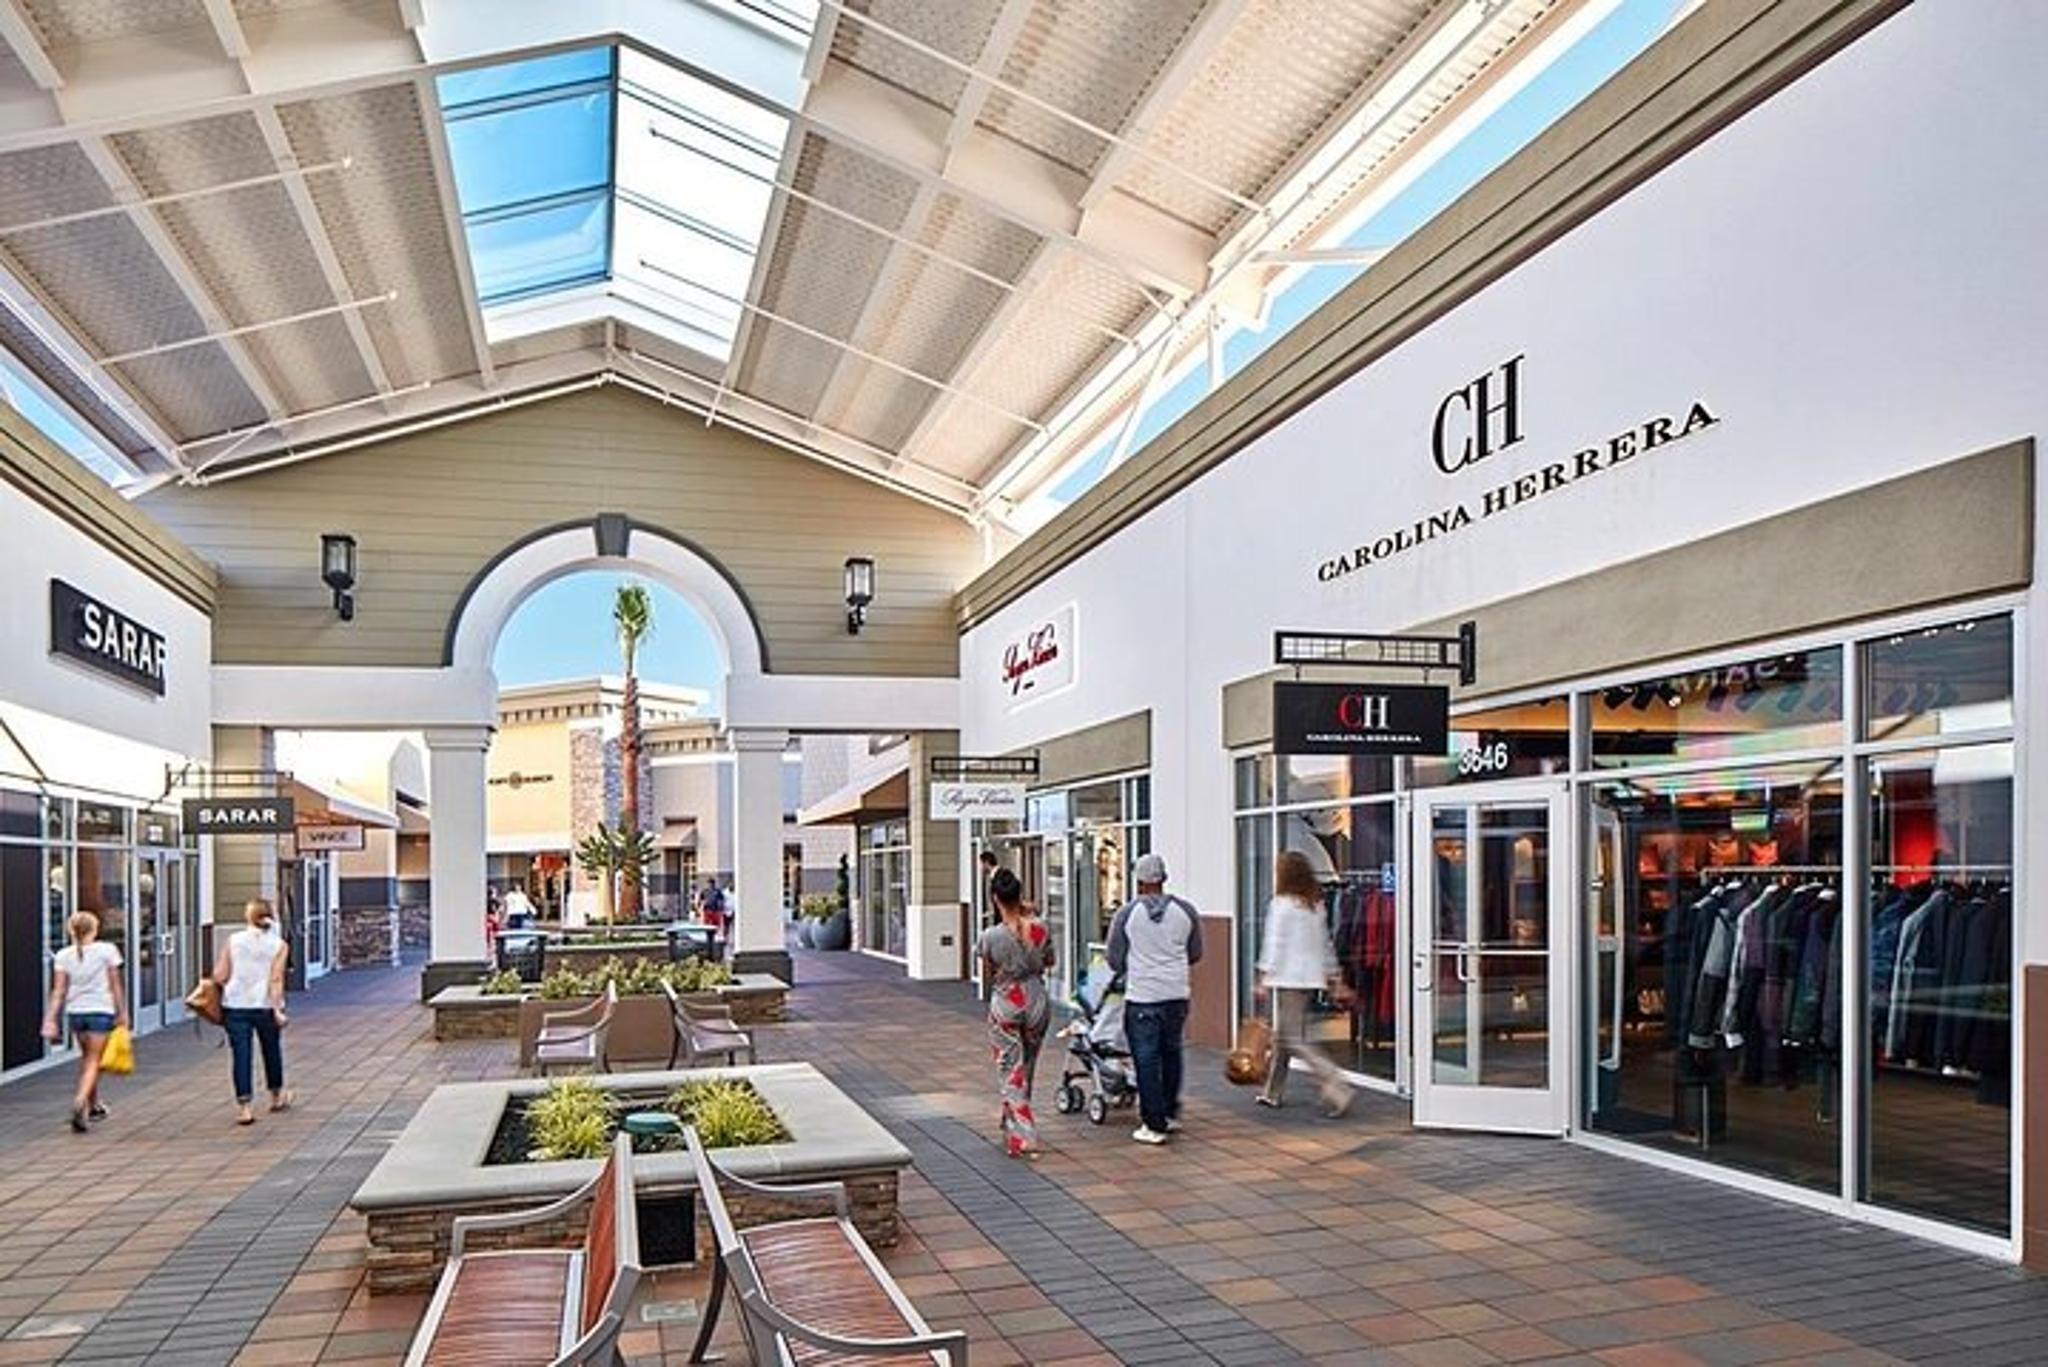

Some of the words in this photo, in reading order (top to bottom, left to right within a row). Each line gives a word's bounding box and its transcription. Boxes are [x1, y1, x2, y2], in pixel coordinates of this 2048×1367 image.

[1432, 354, 1525, 474] CH
[1318, 504, 1474, 582] CAROLINA
[1482, 402, 1721, 518] HERRERA
[1338, 694, 1390, 730] CH
[1458, 742, 1508, 774] 3646
[198, 807, 278, 824] SARAR
